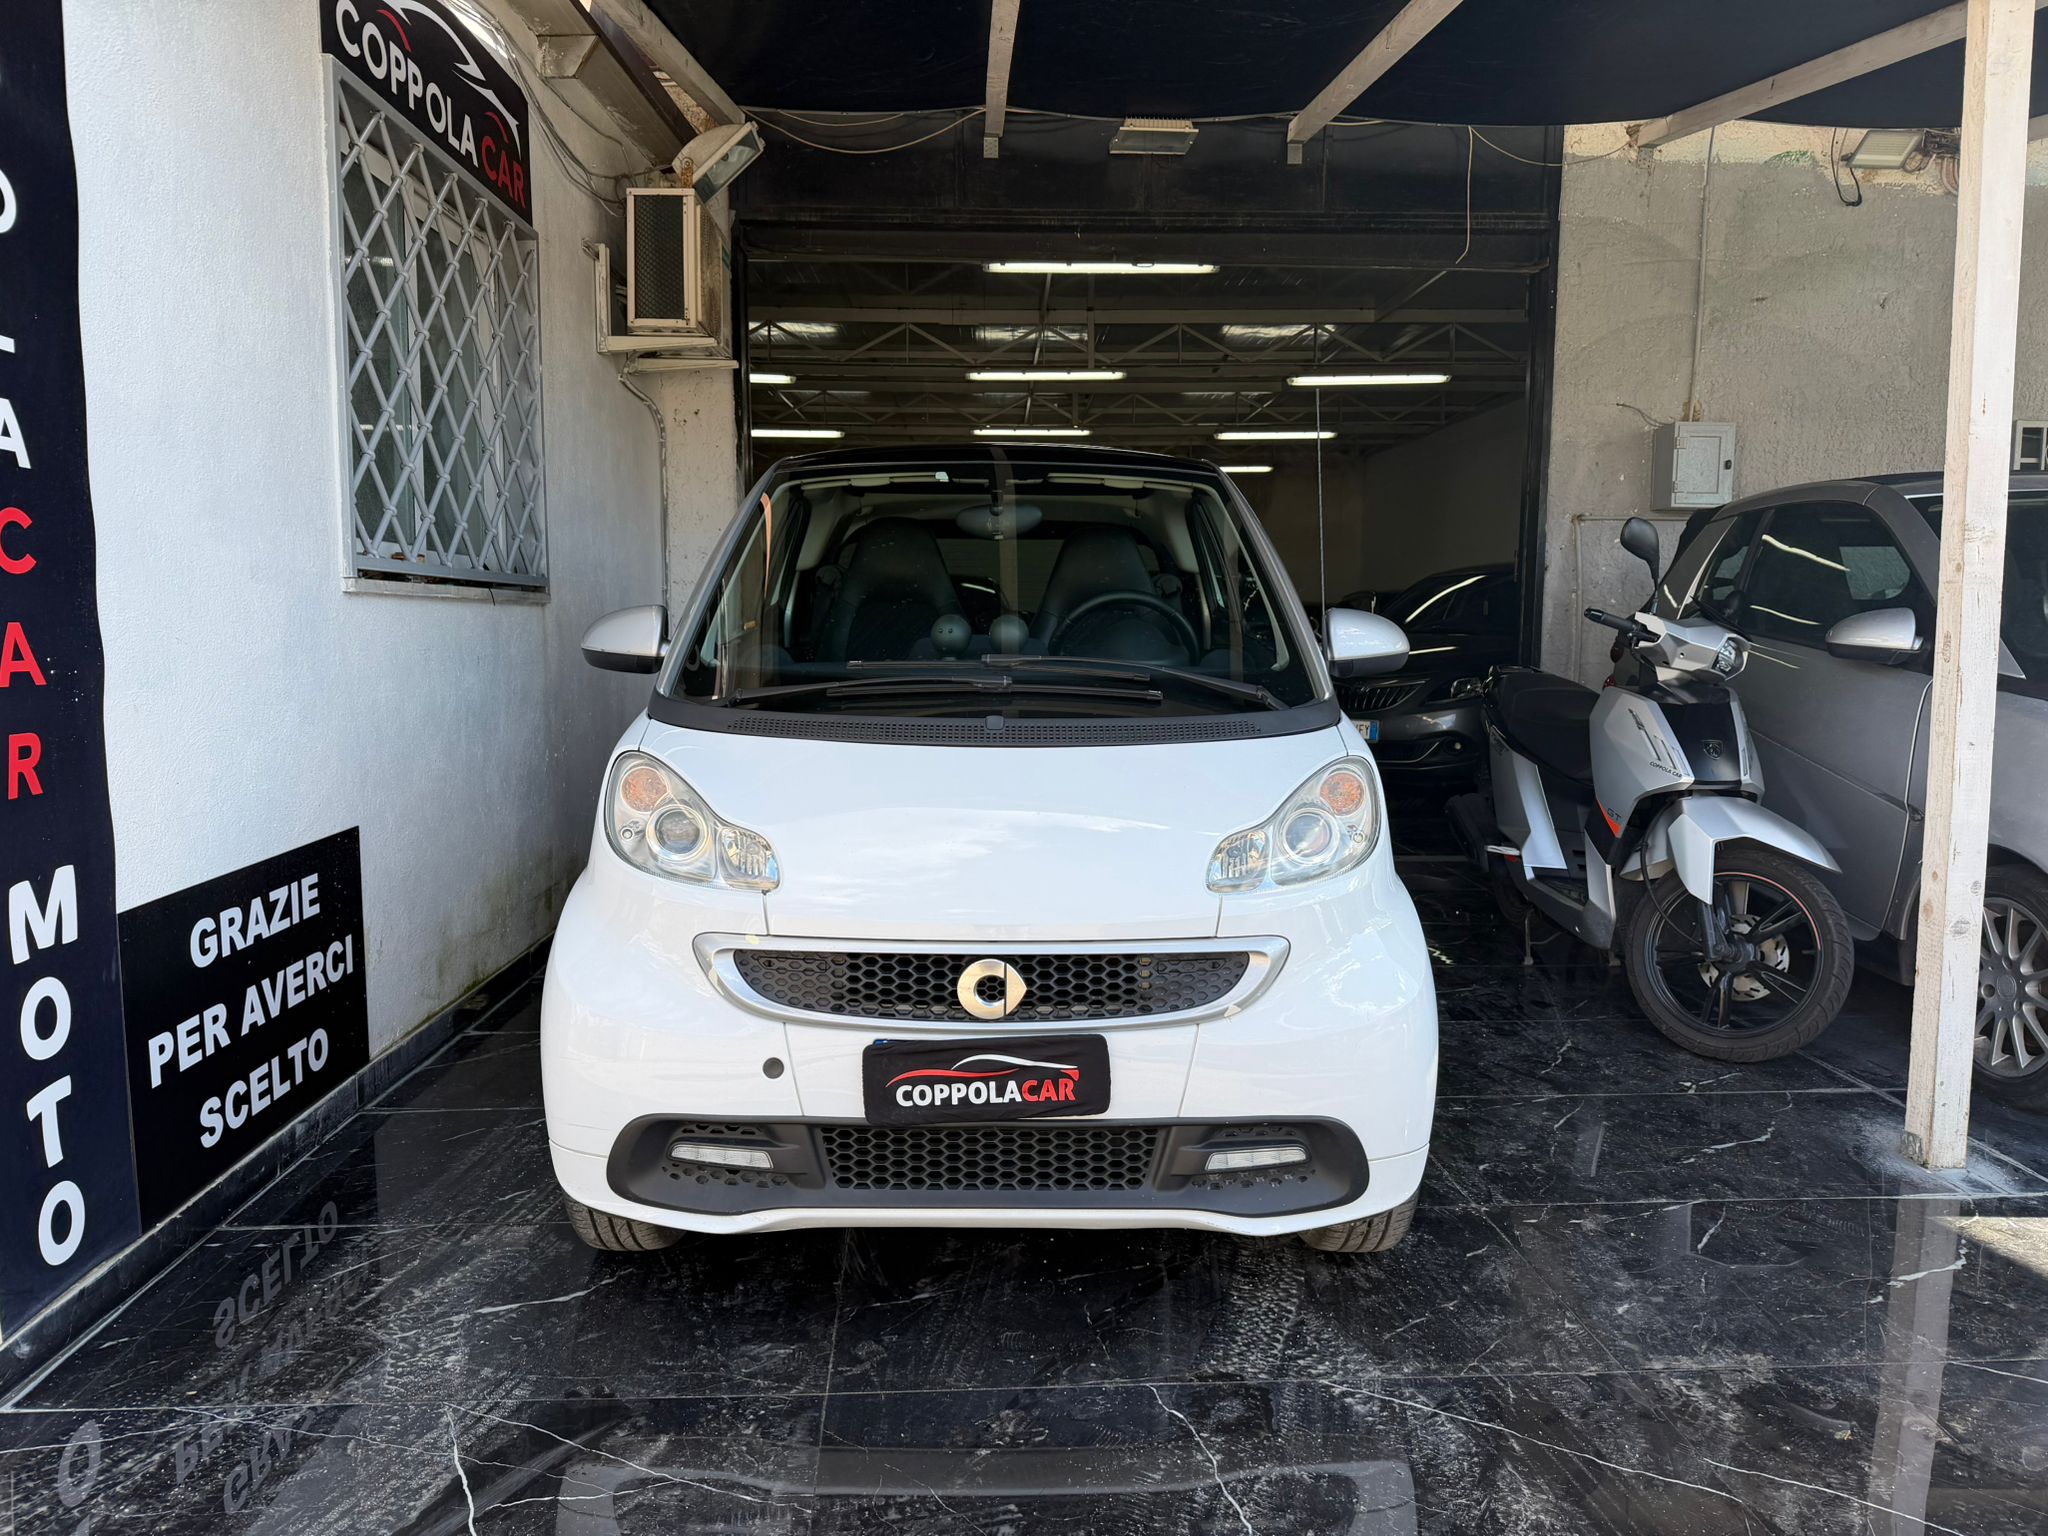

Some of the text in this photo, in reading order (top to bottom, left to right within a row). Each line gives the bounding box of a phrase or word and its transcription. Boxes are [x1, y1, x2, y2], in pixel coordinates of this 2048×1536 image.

[1607, 807, 1622, 822] GT
[190, 872, 321, 968] GRAZIE
[8, 864, 86, 1267] MOTO
[148, 934, 354, 1089] PER AVERCI
[199, 1028, 329, 1149] SCELTO
